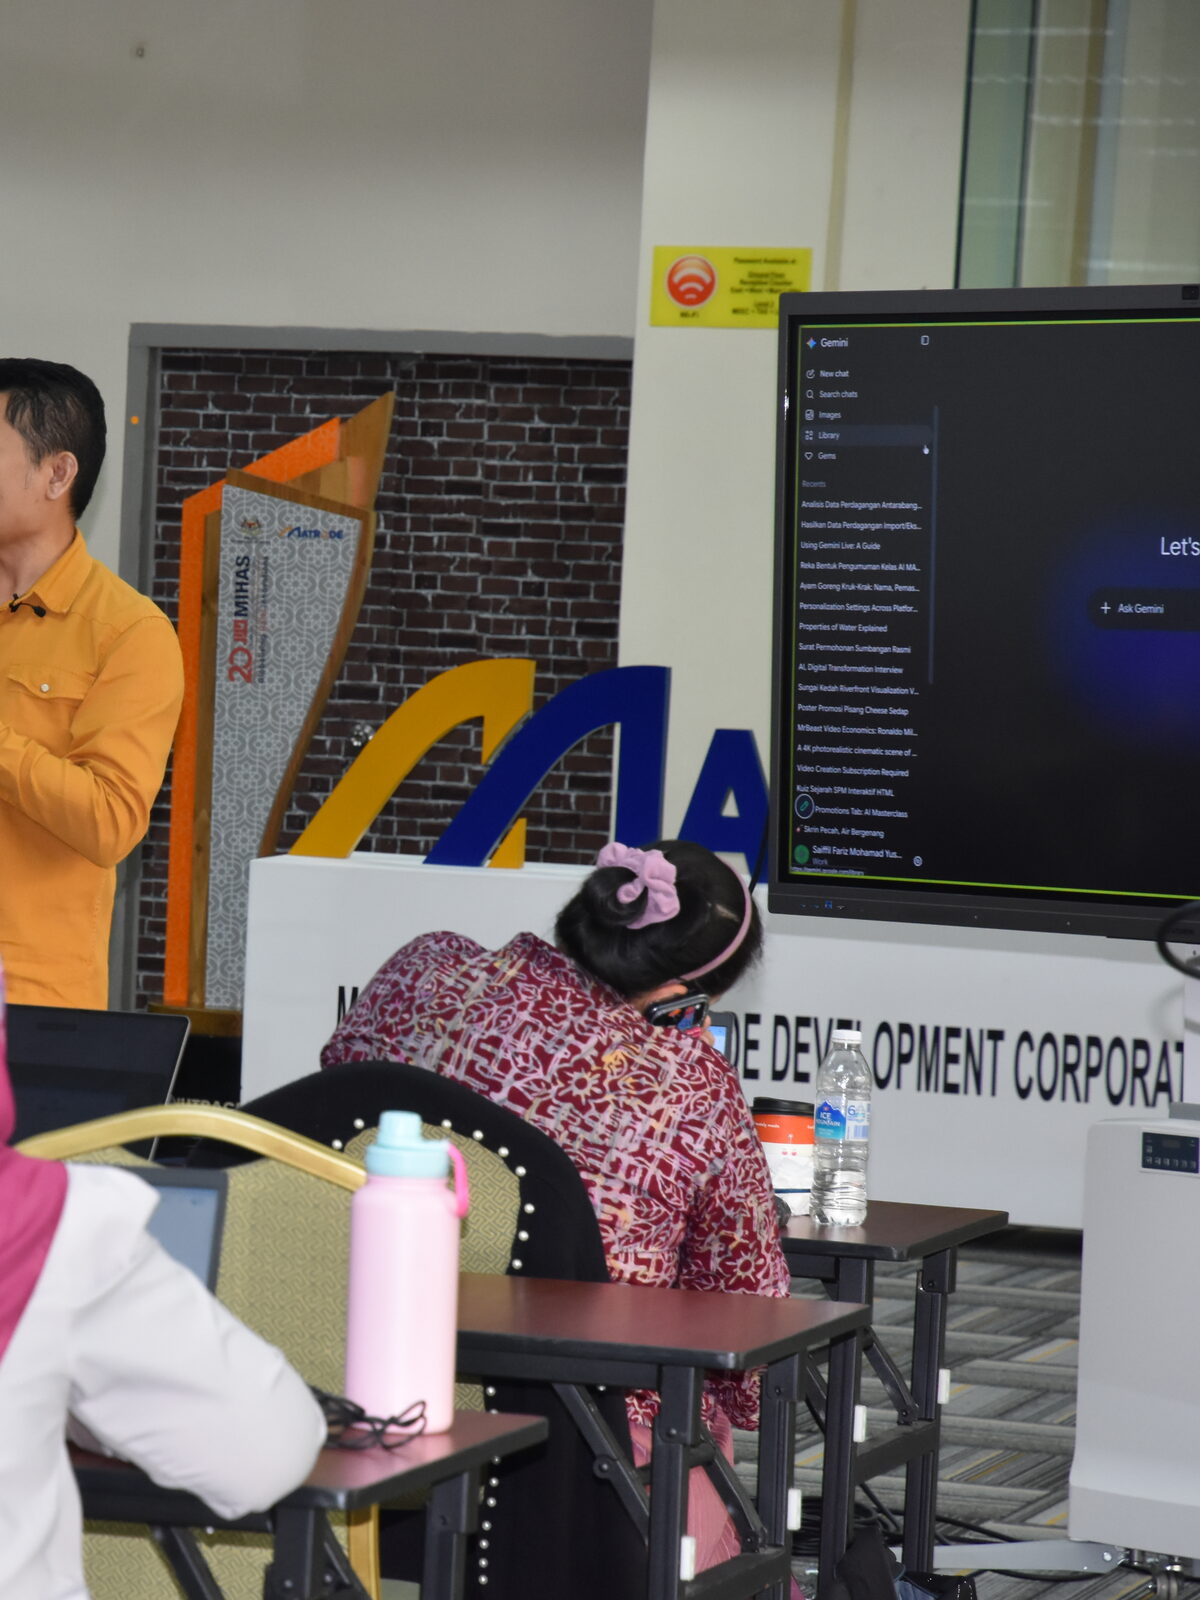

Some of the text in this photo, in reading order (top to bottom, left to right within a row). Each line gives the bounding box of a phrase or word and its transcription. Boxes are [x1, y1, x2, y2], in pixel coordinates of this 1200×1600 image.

[820, 338, 849, 348] Gemini
[819, 390, 858, 398] Search chats
[818, 411, 842, 420] Images
[818, 432, 840, 441] Library
[818, 451, 836, 460] Gems
[800, 541, 818, 551] Using
[819, 541, 840, 549] Gemini
[856, 542, 861, 550] A
[862, 542, 881, 550] Guide
[1160, 536, 1200, 556] Let's
[234, 555, 251, 617] MIHAS
[845, 603, 871, 613] Settings
[871, 604, 892, 612] Across
[1117, 603, 1164, 614] Ask Gemini
[799, 622, 830, 631] Properties
[831, 623, 838, 631] of
[858, 624, 888, 633] Explained
[828, 662, 874, 672] Transformation
[874, 664, 904, 674] Interview
[865, 706, 888, 714] Cheese
[823, 725, 841, 733] Video
[797, 764, 815, 772] Video
[881, 768, 909, 778] Required
[771, 1013, 1005, 1098] DEVOPMENT
[820, 1111, 832, 1120] ICE
